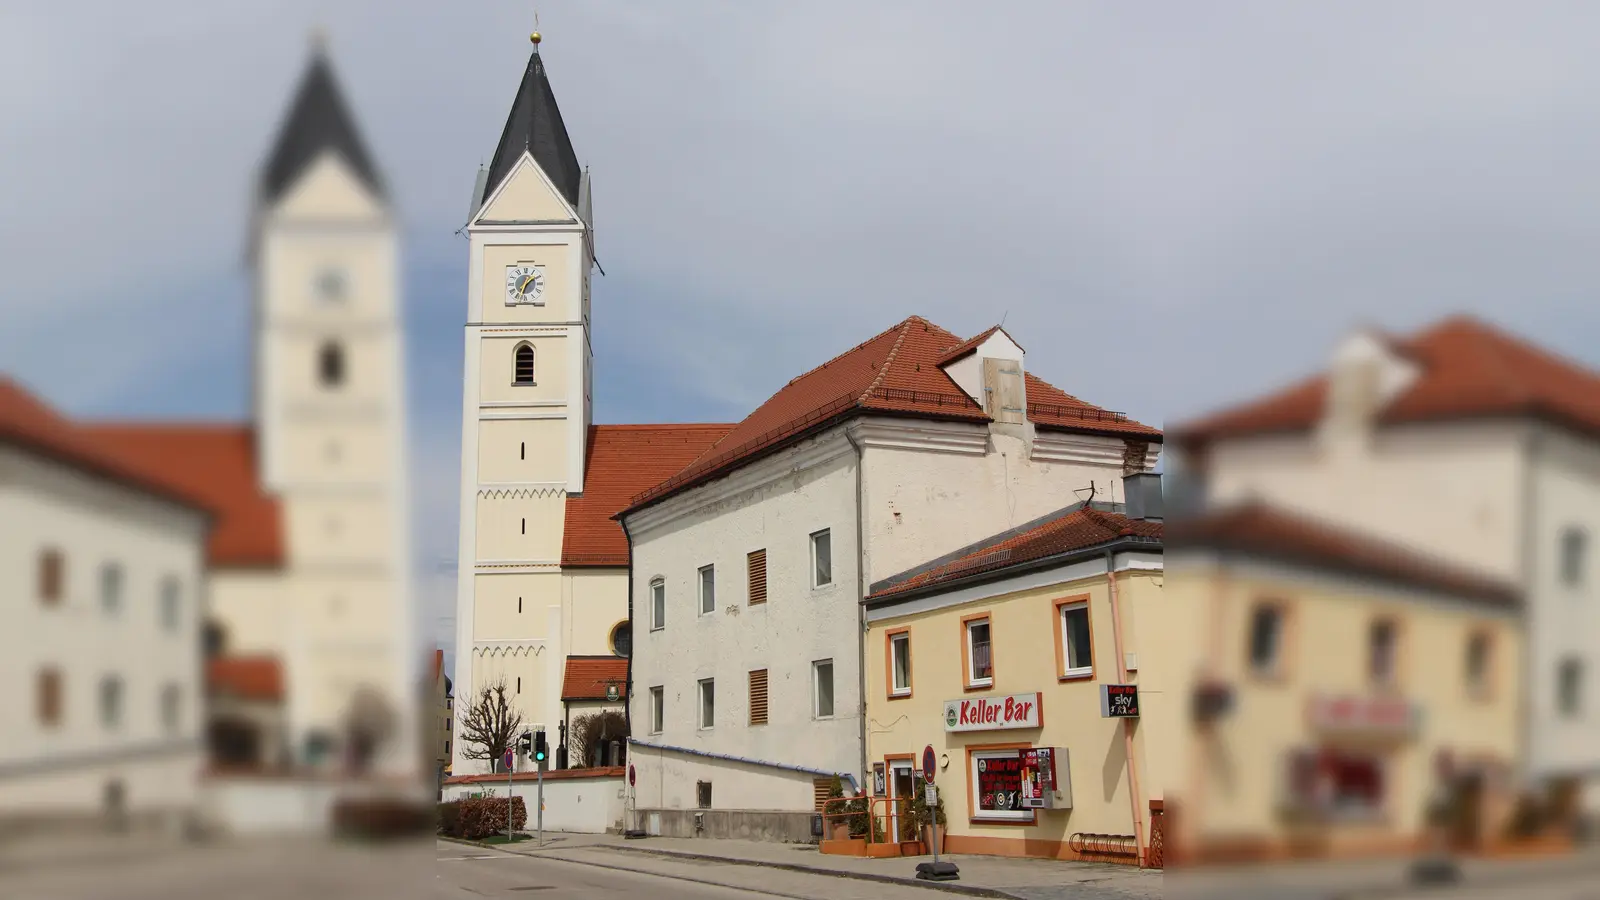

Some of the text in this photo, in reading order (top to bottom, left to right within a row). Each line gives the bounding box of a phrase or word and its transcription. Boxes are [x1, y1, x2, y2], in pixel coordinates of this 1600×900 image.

[1115, 694, 1132, 707] sky
[960, 696, 1032, 725] Keller Bar
[987, 760, 1019, 772] Keller Bar
